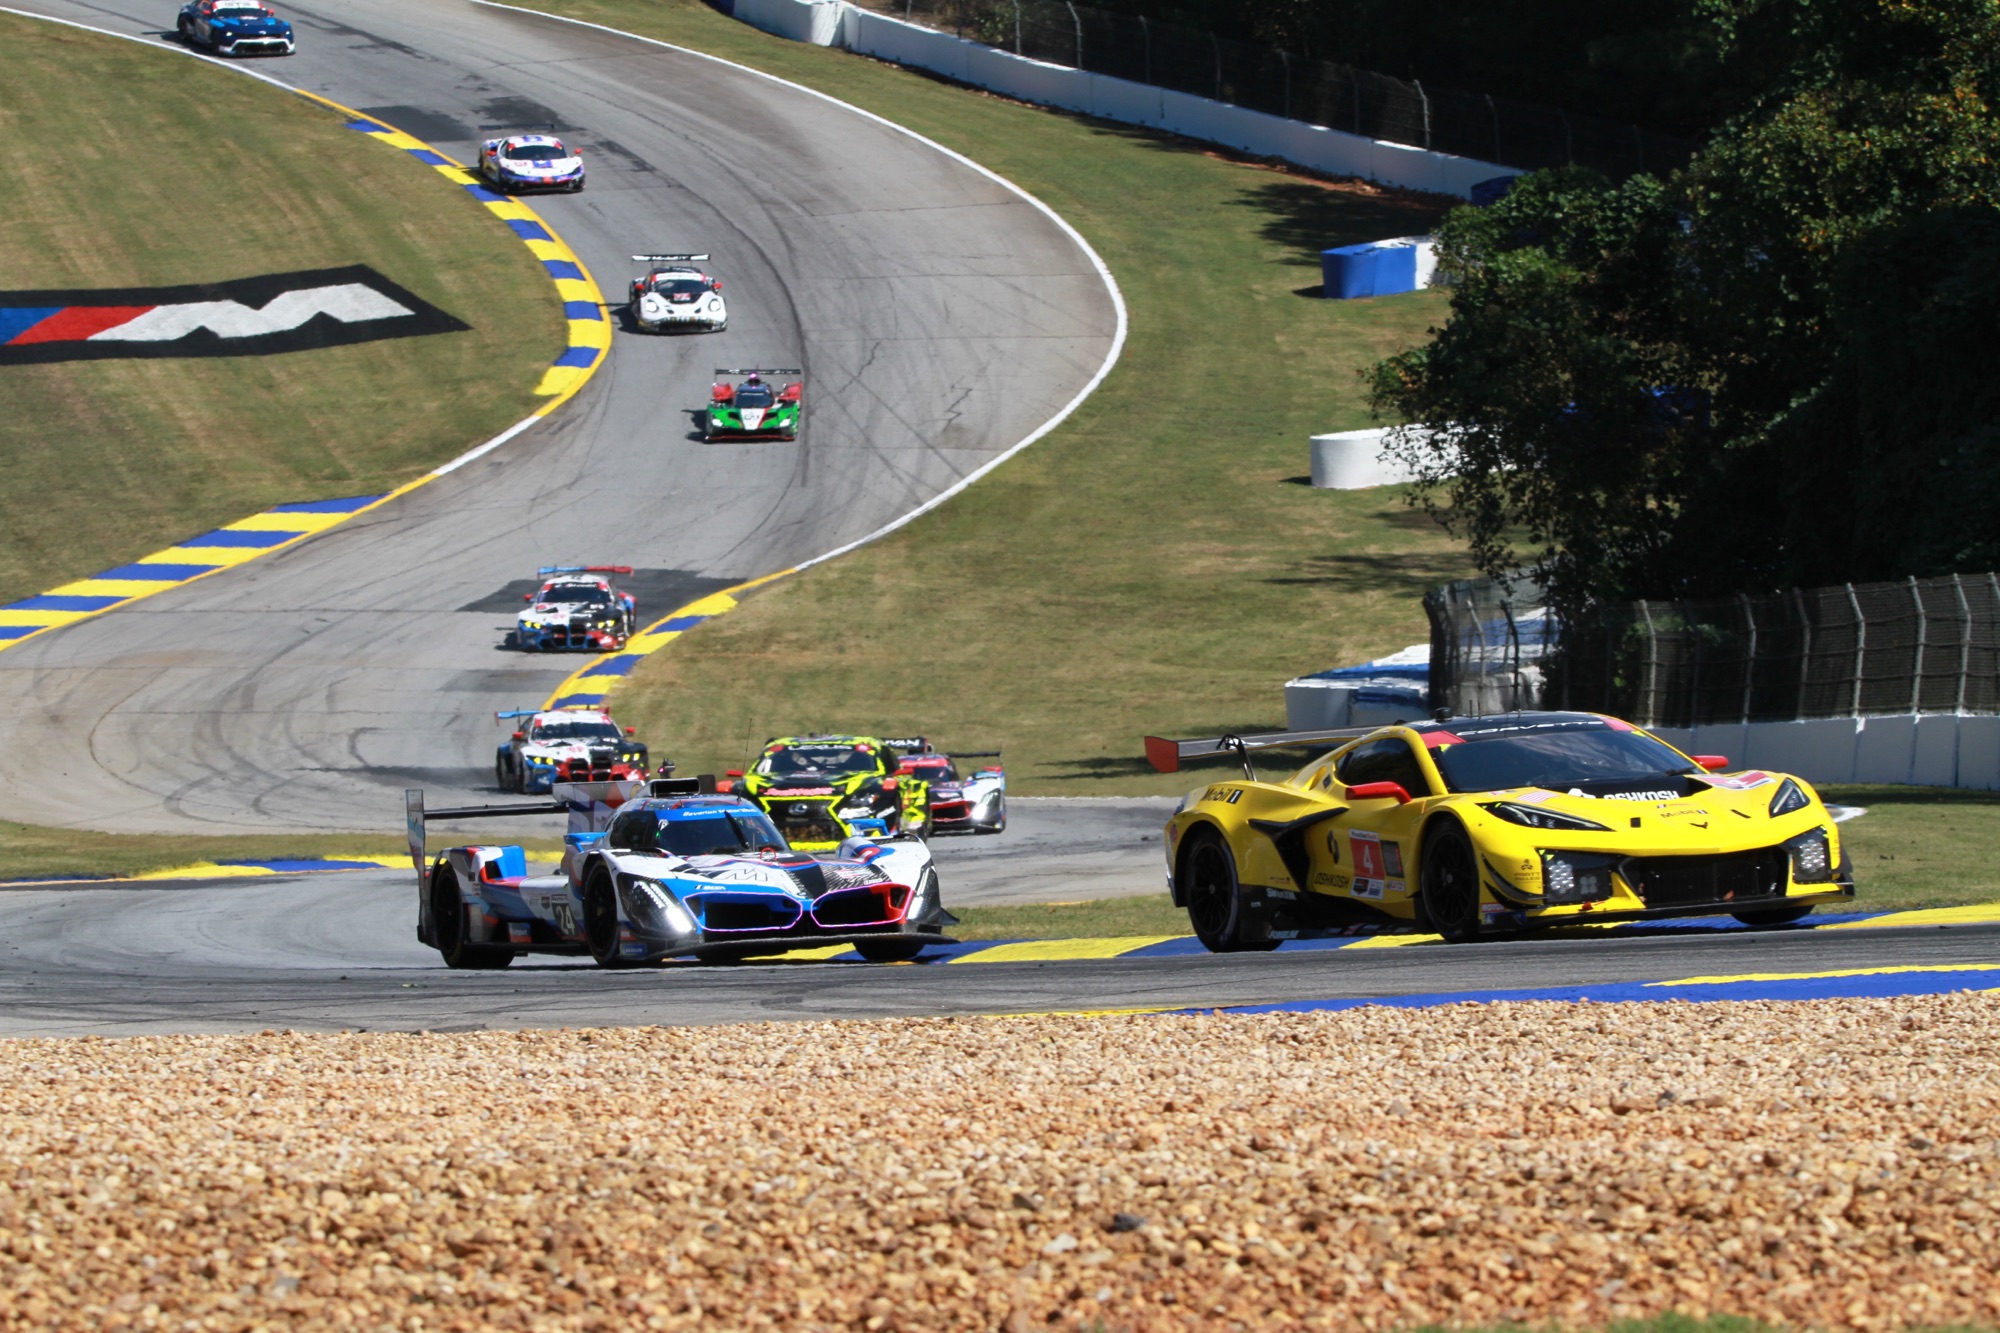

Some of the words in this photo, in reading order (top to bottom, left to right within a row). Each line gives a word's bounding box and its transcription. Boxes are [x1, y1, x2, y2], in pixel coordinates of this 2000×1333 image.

[1456, 720, 1604, 736] CORVETTE
[1200, 787, 1233, 802] Mobil
[1227, 789, 1244, 804] 1
[1603, 790, 1681, 802] OSHKOSH
[1362, 844, 1374, 876] 4
[1313, 872, 1350, 889] OSHKOSH
[556, 905, 576, 935] 24
